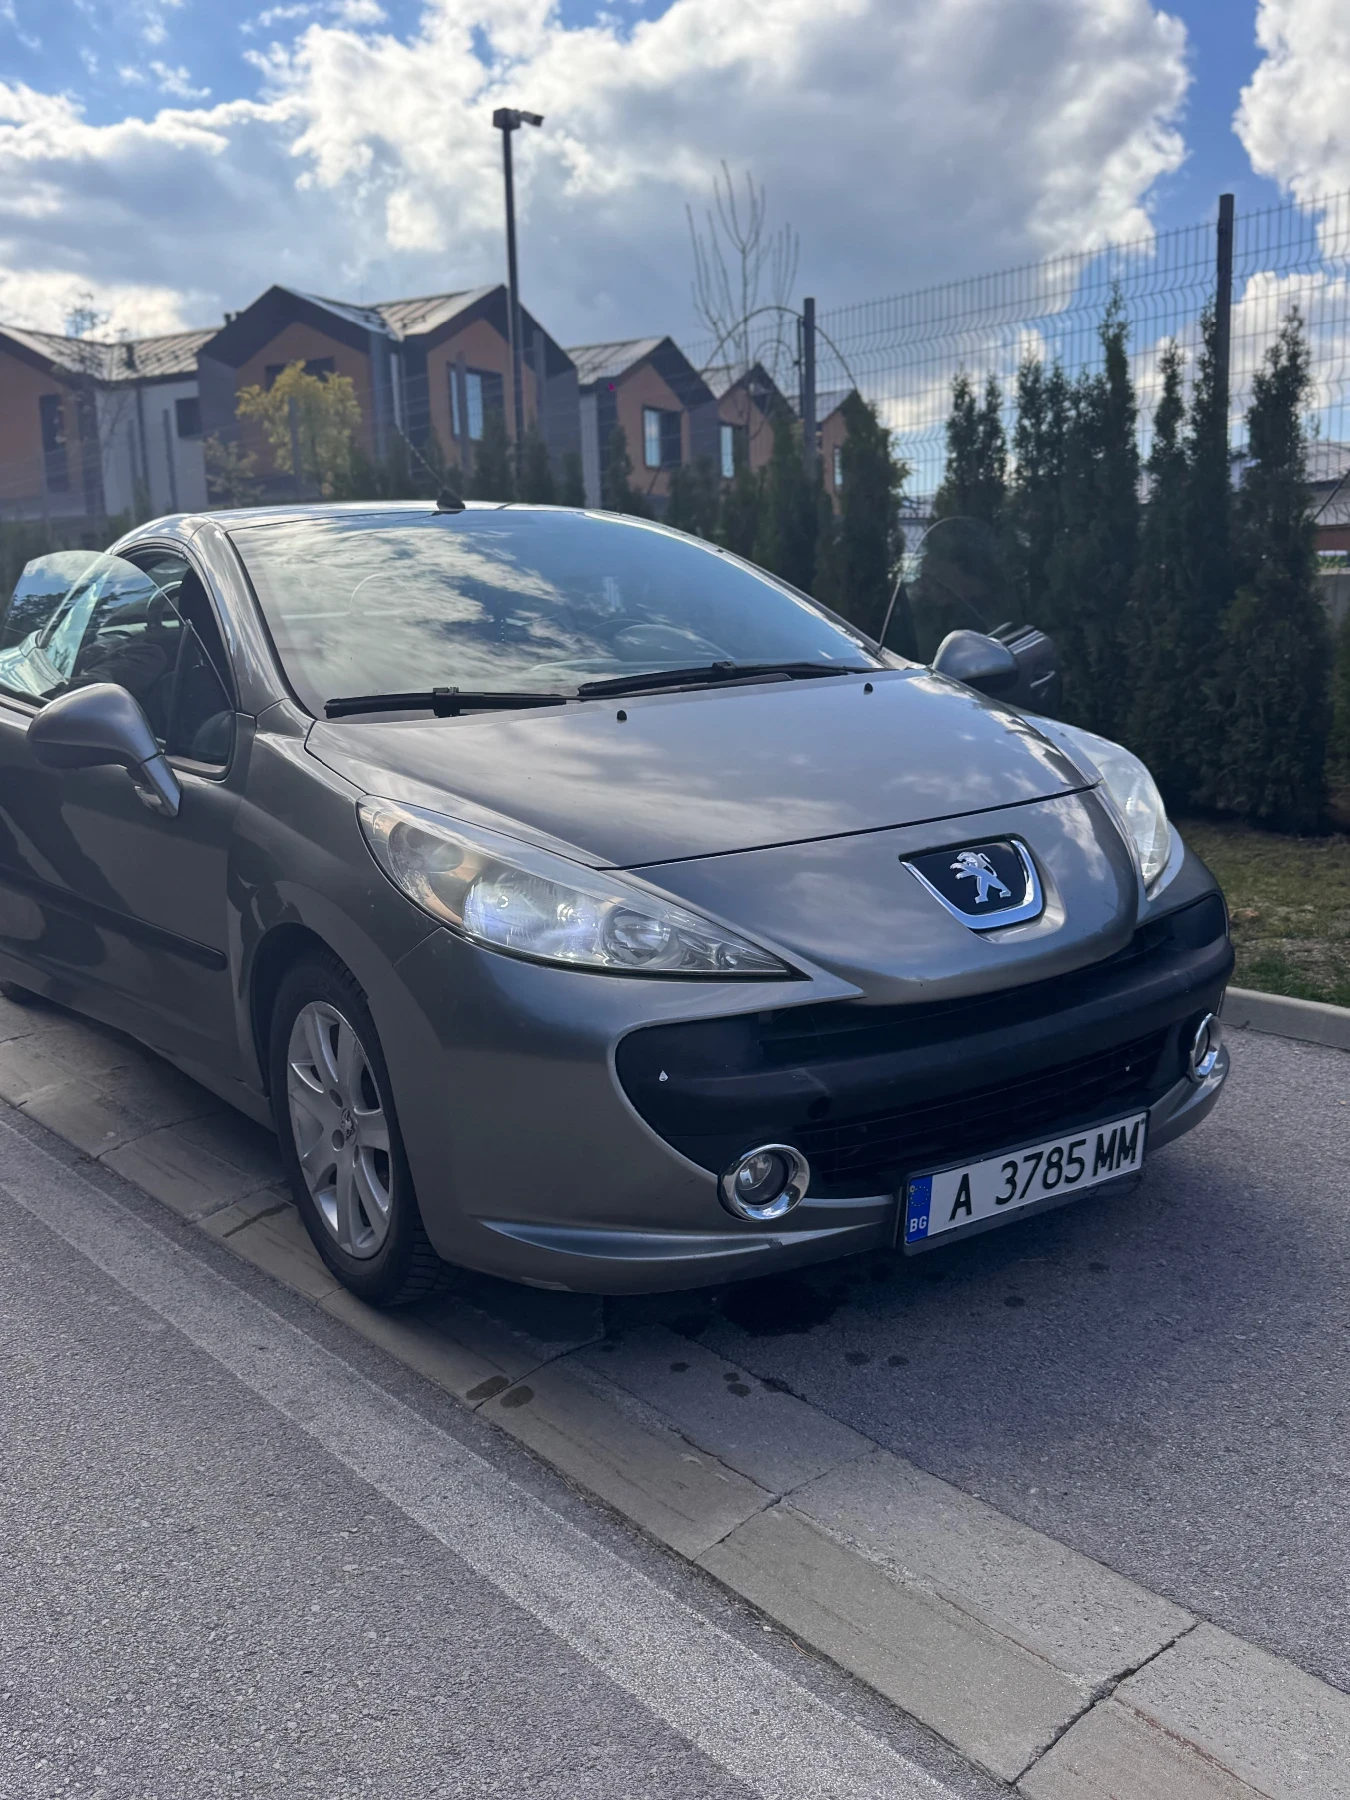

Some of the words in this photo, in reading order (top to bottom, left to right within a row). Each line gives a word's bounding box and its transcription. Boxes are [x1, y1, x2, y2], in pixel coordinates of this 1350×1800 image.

[949, 1173, 972, 1222] A
[995, 1138, 1087, 1206] 3785
[1092, 1121, 1140, 1177] MM
[909, 1215, 928, 1233] BG
